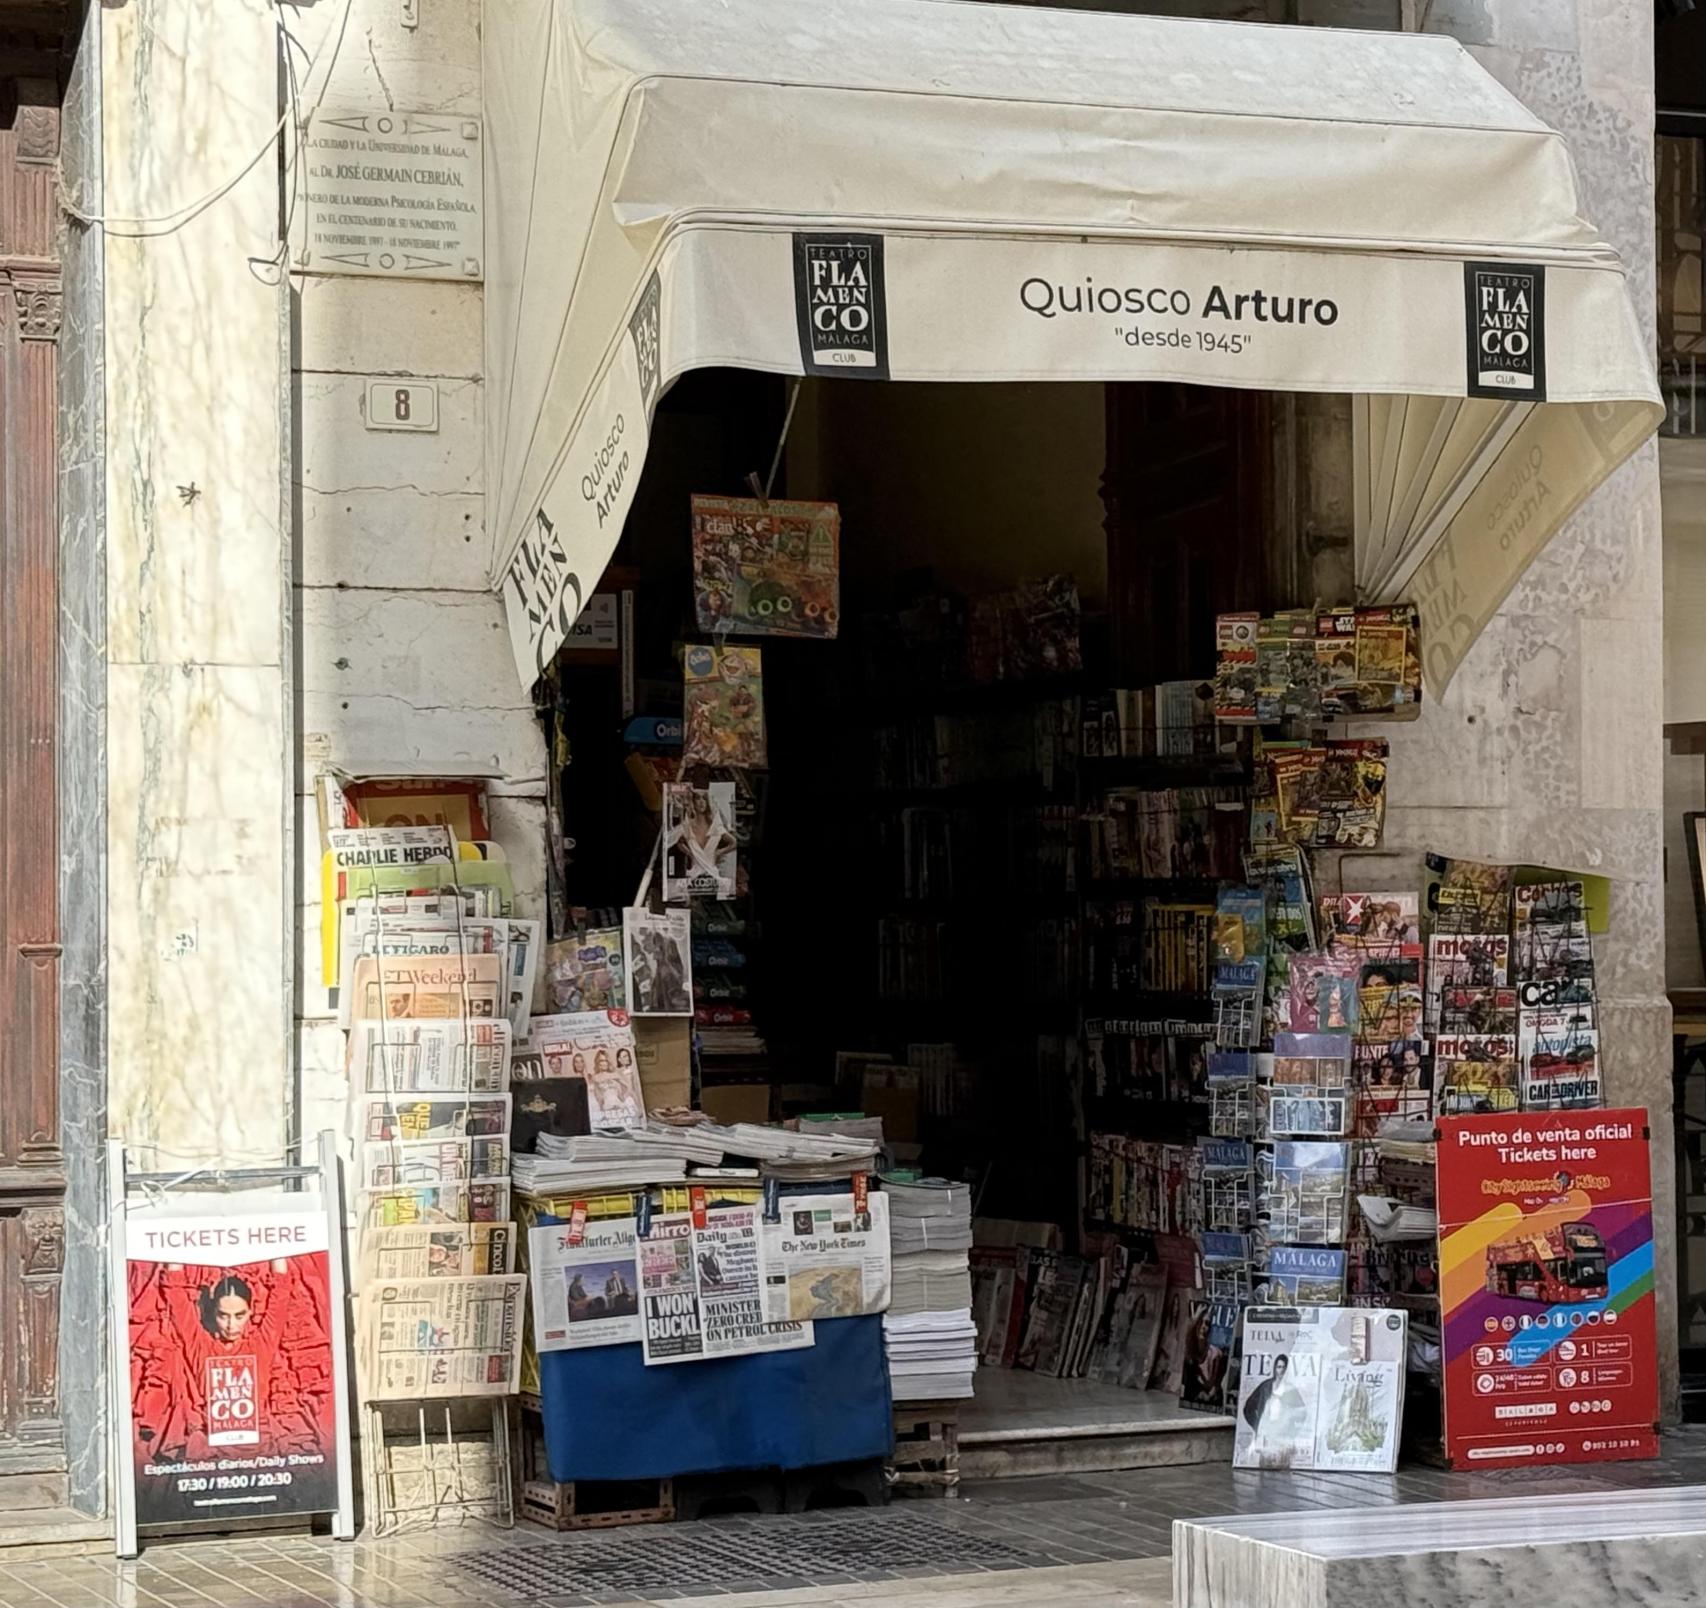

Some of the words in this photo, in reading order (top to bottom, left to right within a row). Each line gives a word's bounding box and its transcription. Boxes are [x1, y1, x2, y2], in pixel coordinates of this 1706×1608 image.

[336, 162, 360, 180] JOSÉ
[362, 166, 412, 183] GERMAIN
[330, 195, 340, 204] DE
[341, 196, 351, 205] LA
[352, 196, 389, 207] MODERNA
[317, 213, 327, 223] EN
[328, 214, 338, 224] EL
[339, 214, 385, 226] CENTENARIO
[387, 217, 397, 227] DE
[810, 248, 868, 261] TEATRO
[811, 260, 868, 286] FLA
[1480, 276, 1530, 289] TEATRO
[812, 287, 867, 304] MEN
[1019, 276, 1191, 318] Quiosco
[1201, 285, 1338, 326] Arturo
[1480, 286, 1530, 313] FLA
[813, 305, 869, 331] CO
[1480, 312, 1529, 330] MEN
[1114, 326, 1192, 349] "desde
[1196, 331, 1251, 354] 1945"
[1481, 329, 1529, 355] CO
[832, 353, 857, 363] CLUB
[1495, 375, 1516, 385] CLUB
[395, 389, 410, 421] 8
[580, 413, 626, 502] Quiosco
[595, 450, 630, 529] Arturo
[573, 624, 592, 636] ISA
[656, 722, 682, 737] Orbi
[1436, 939, 1507, 955] moos
[1529, 1084, 1551, 1101] CAR
[1557, 1080, 1598, 1098] DRIVER
[1458, 1131, 1508, 1147] Punto
[1512, 1128, 1532, 1144] de
[1536, 1127, 1580, 1142] venta
[1585, 1123, 1632, 1140] oficial
[1498, 1147, 1556, 1163] Tickets
[1561, 1145, 1597, 1161] here
[145, 1229, 240, 1249] TICKETS
[248, 1226, 307, 1244] HERE
[696, 1230, 728, 1244] Daily
[782, 1241, 800, 1252] The
[800, 1240, 819, 1251] New
[819, 1240, 840, 1252] York
[840, 1237, 866, 1249] Times
[646, 1297, 654, 1318] I
[1189, 1301, 1240, 1328] VGUE
[706, 1328, 723, 1342] ON
[724, 1323, 767, 1341] PETROL
[768, 1320, 803, 1335] CRISIS
[707, 1315, 732, 1329] ZERO
[1495, 1348, 1513, 1362] 30
[1581, 1344, 1589, 1356] 1
[1244, 1353, 1318, 1378] TEVA
[211, 1367, 254, 1387] FLA
[1580, 1371, 1590, 1384] 8
[210, 1386, 252, 1401] MEN
[211, 1399, 255, 1420] CO
[144, 1460, 216, 1476] Espectáculos
[288, 1453, 325, 1466] Shows
[177, 1478, 208, 1492] 17:30
[216, 1475, 248, 1489] 19:00
[258, 1472, 292, 1487] 20:30
